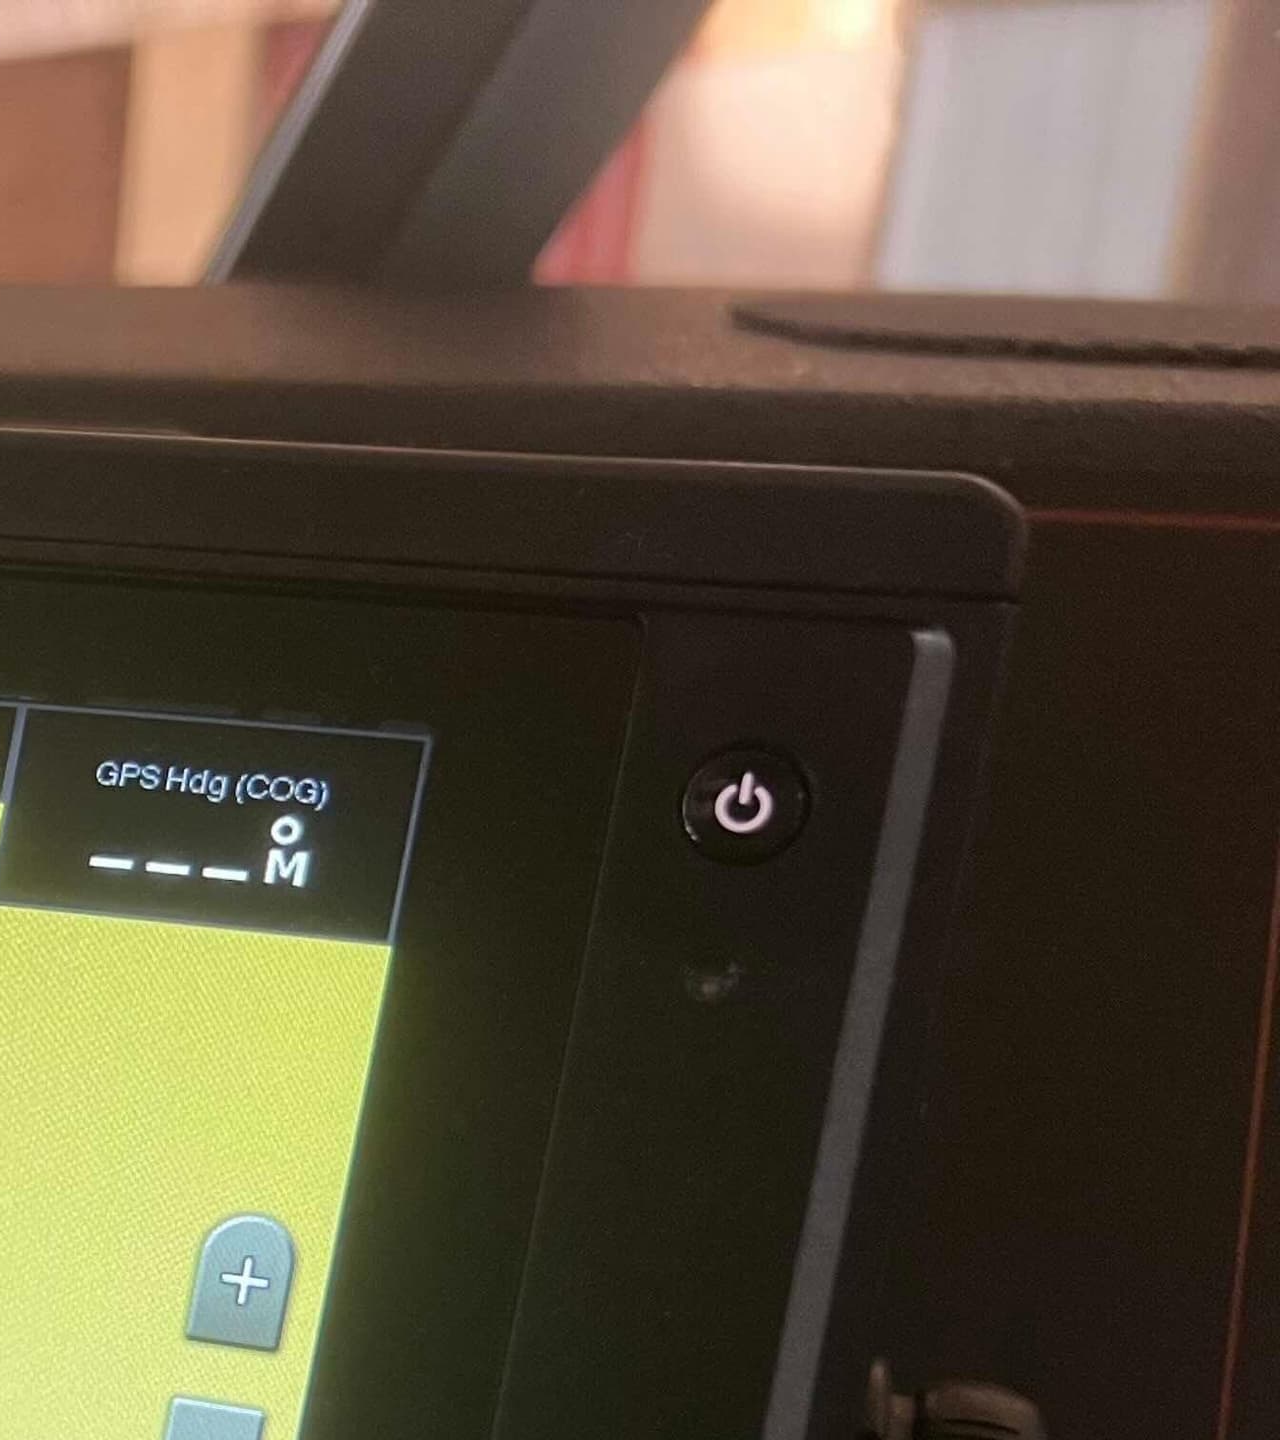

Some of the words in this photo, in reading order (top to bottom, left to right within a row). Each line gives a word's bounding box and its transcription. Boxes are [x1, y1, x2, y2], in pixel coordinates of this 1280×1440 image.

[95, 760, 161, 790] GPS
[165, 767, 228, 803] Hdg
[235, 773, 330, 811] (COG)
